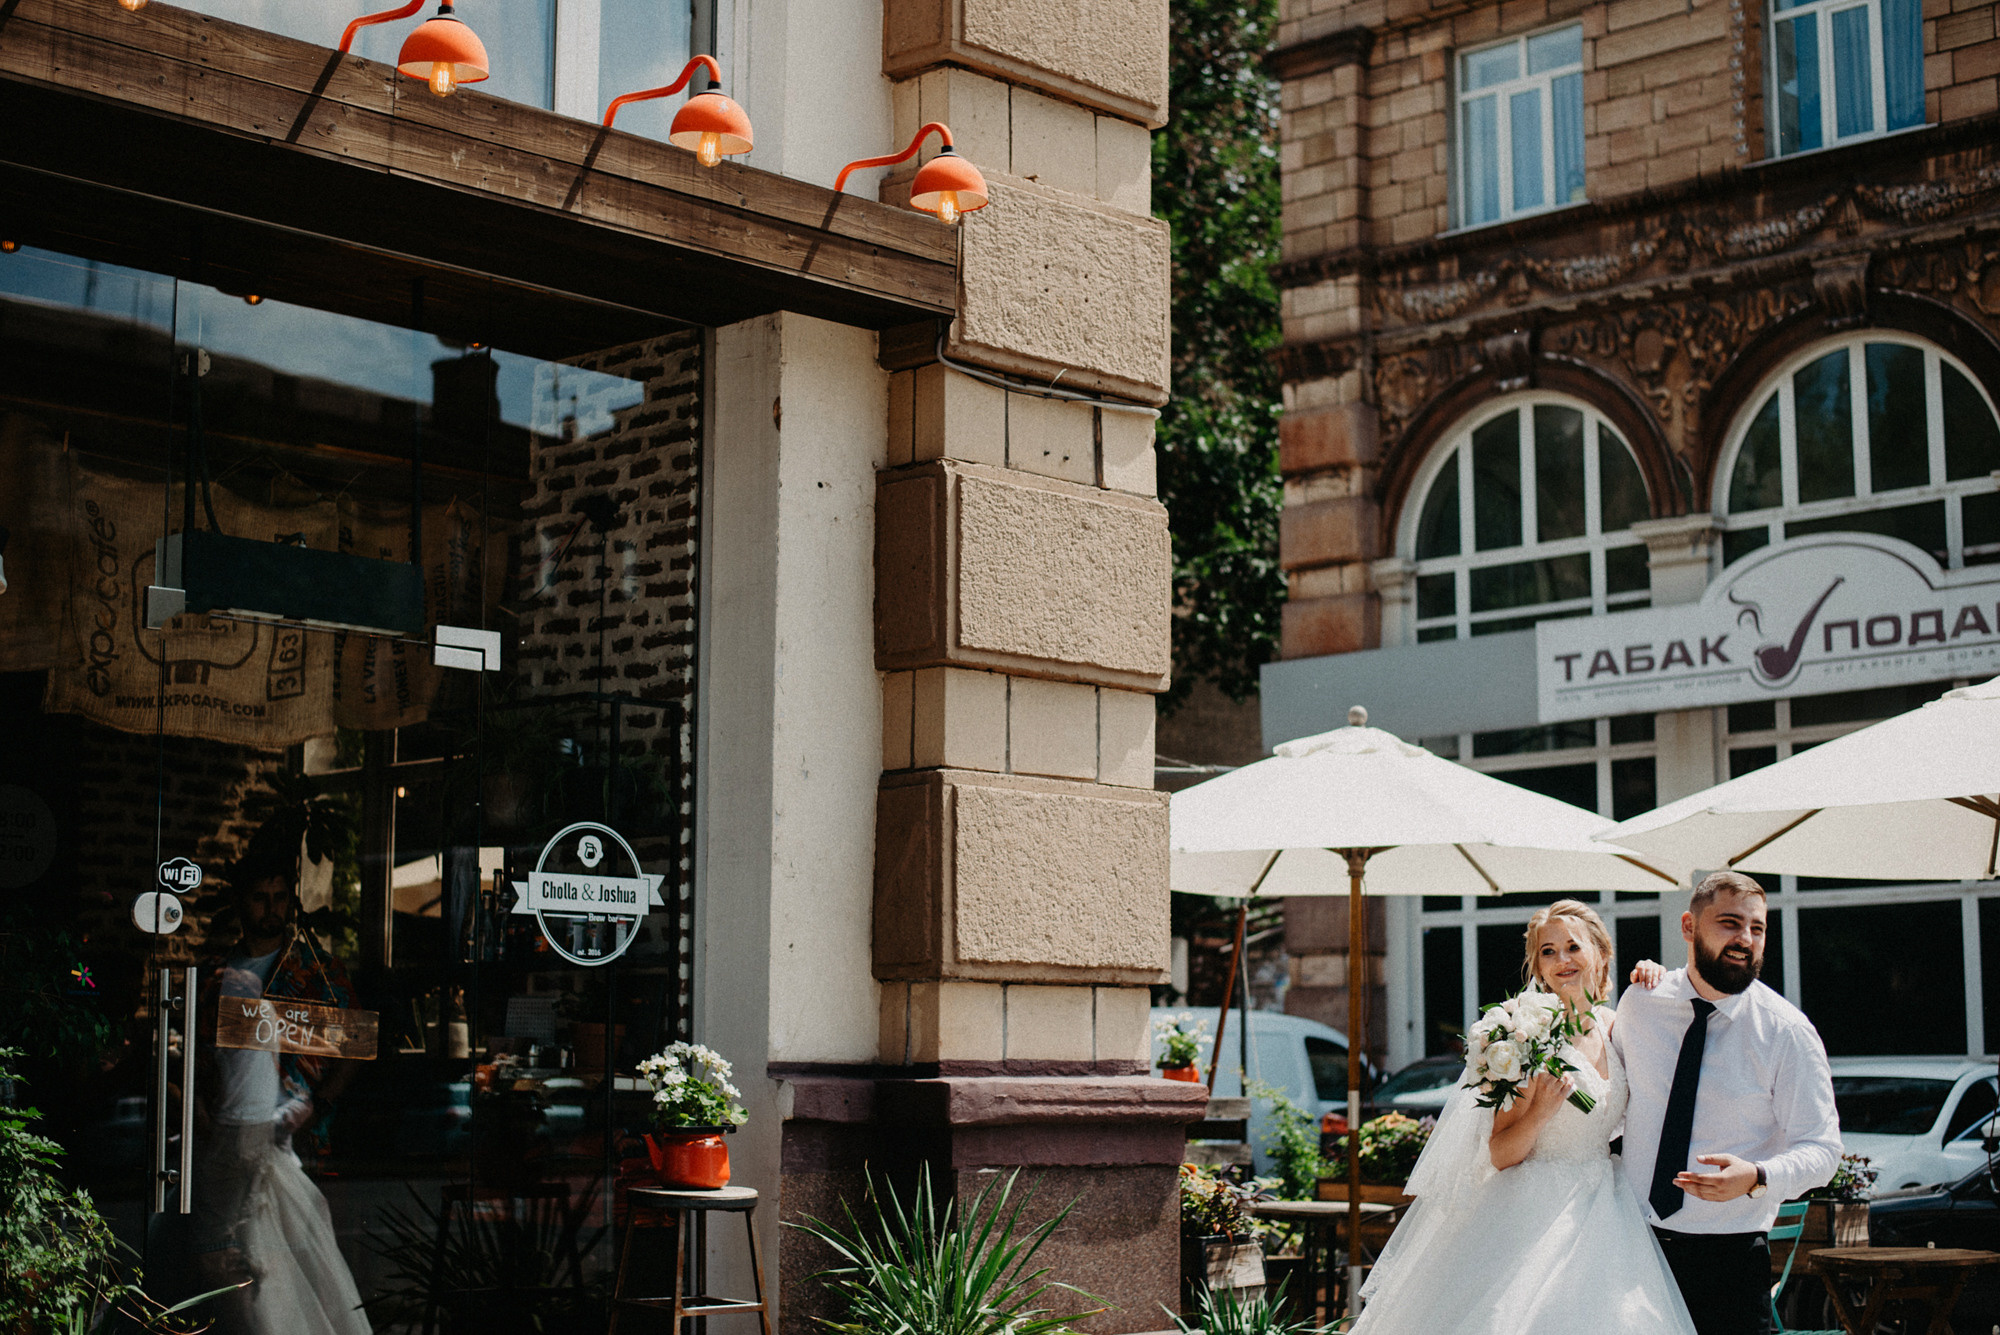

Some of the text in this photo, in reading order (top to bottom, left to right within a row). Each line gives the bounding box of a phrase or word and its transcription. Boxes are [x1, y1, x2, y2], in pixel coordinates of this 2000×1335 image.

[1824, 602, 2000, 653] ПОДА
[1554, 634, 1731, 682] ТАБАК
[542, 881, 637, 904] Cholla & Joshua
[588, 912, 619, 923] Brew bar
[286, 1009, 309, 1023] are
